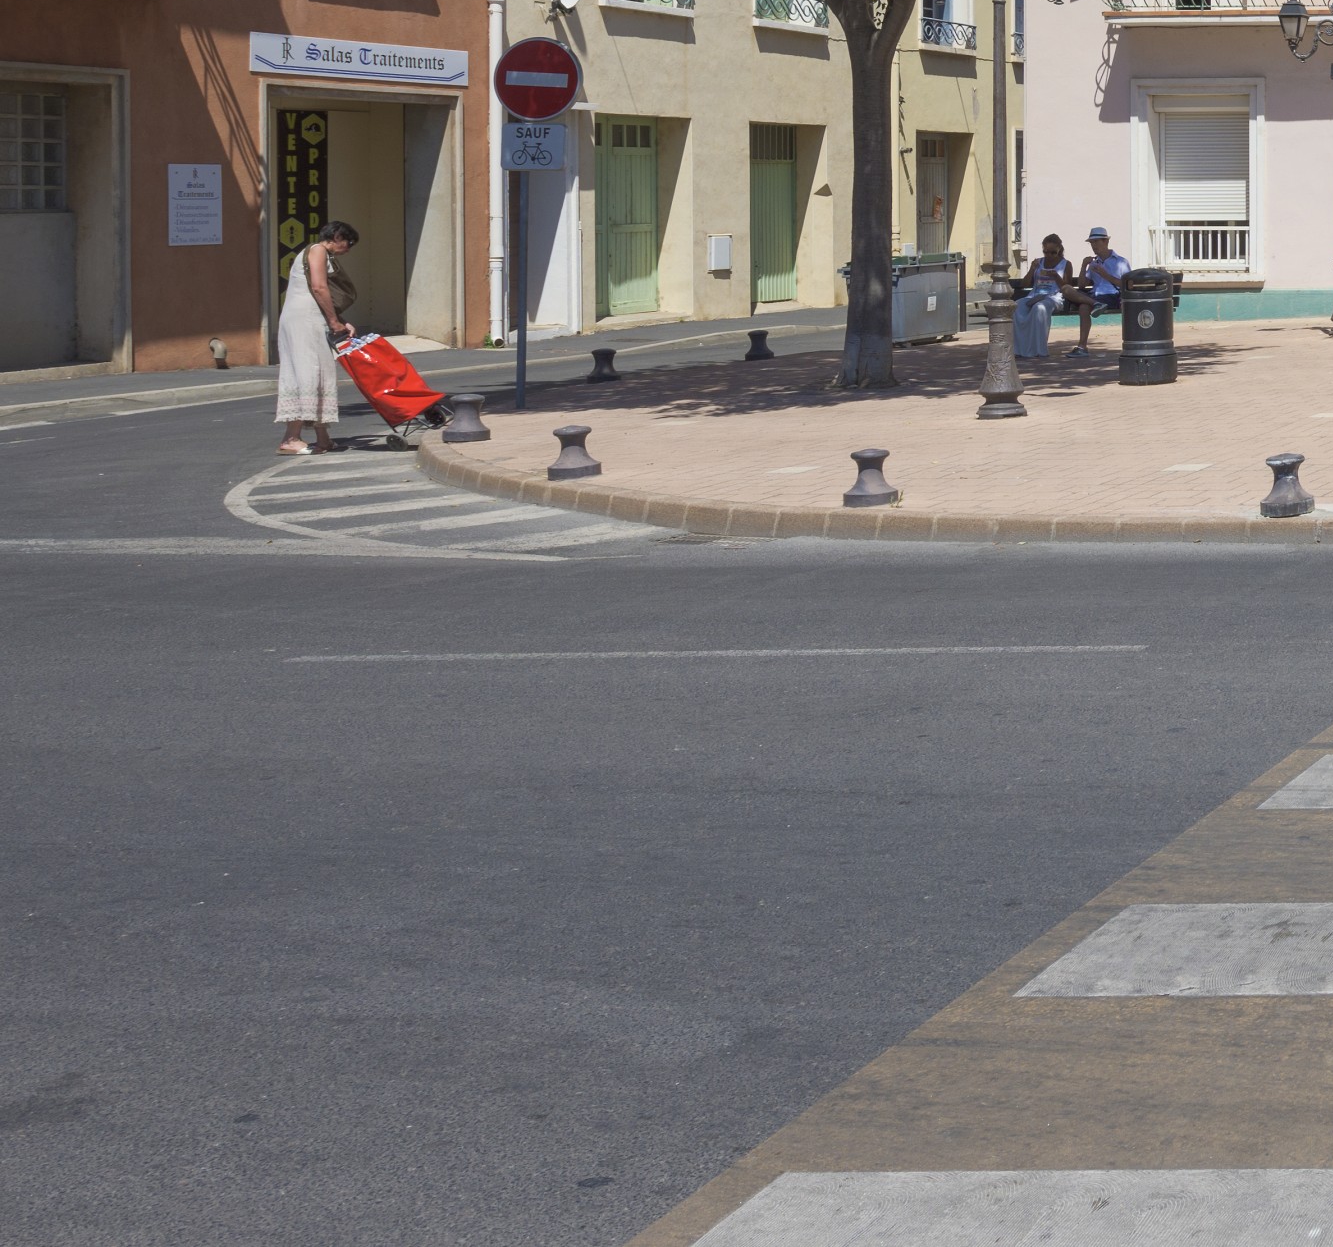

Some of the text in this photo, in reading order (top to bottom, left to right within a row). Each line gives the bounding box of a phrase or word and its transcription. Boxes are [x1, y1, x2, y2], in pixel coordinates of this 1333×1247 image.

[305, 43, 353, 64] Salas
[358, 47, 445, 71] Traitements
[516, 127, 551, 139] SAUF
[285, 112, 298, 215] VENTE
